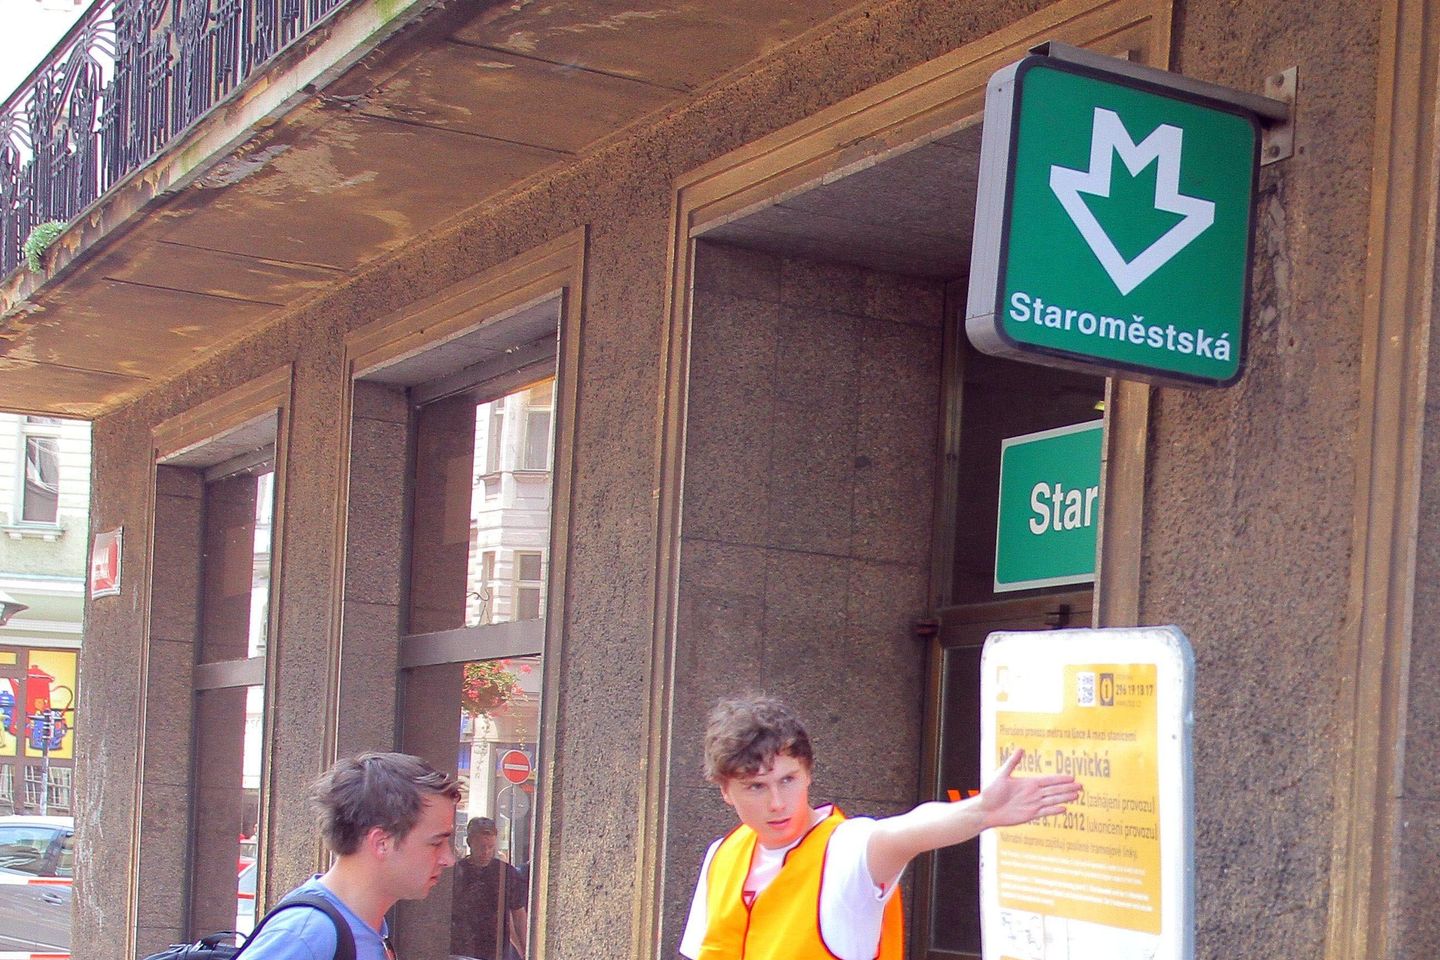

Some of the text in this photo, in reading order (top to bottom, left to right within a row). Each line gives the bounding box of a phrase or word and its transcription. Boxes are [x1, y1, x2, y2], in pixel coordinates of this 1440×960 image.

[1009, 292, 1232, 361] Staroměstská
[1029, 482, 1099, 535] Star
[1056, 749, 1110, 778] Dejvická
